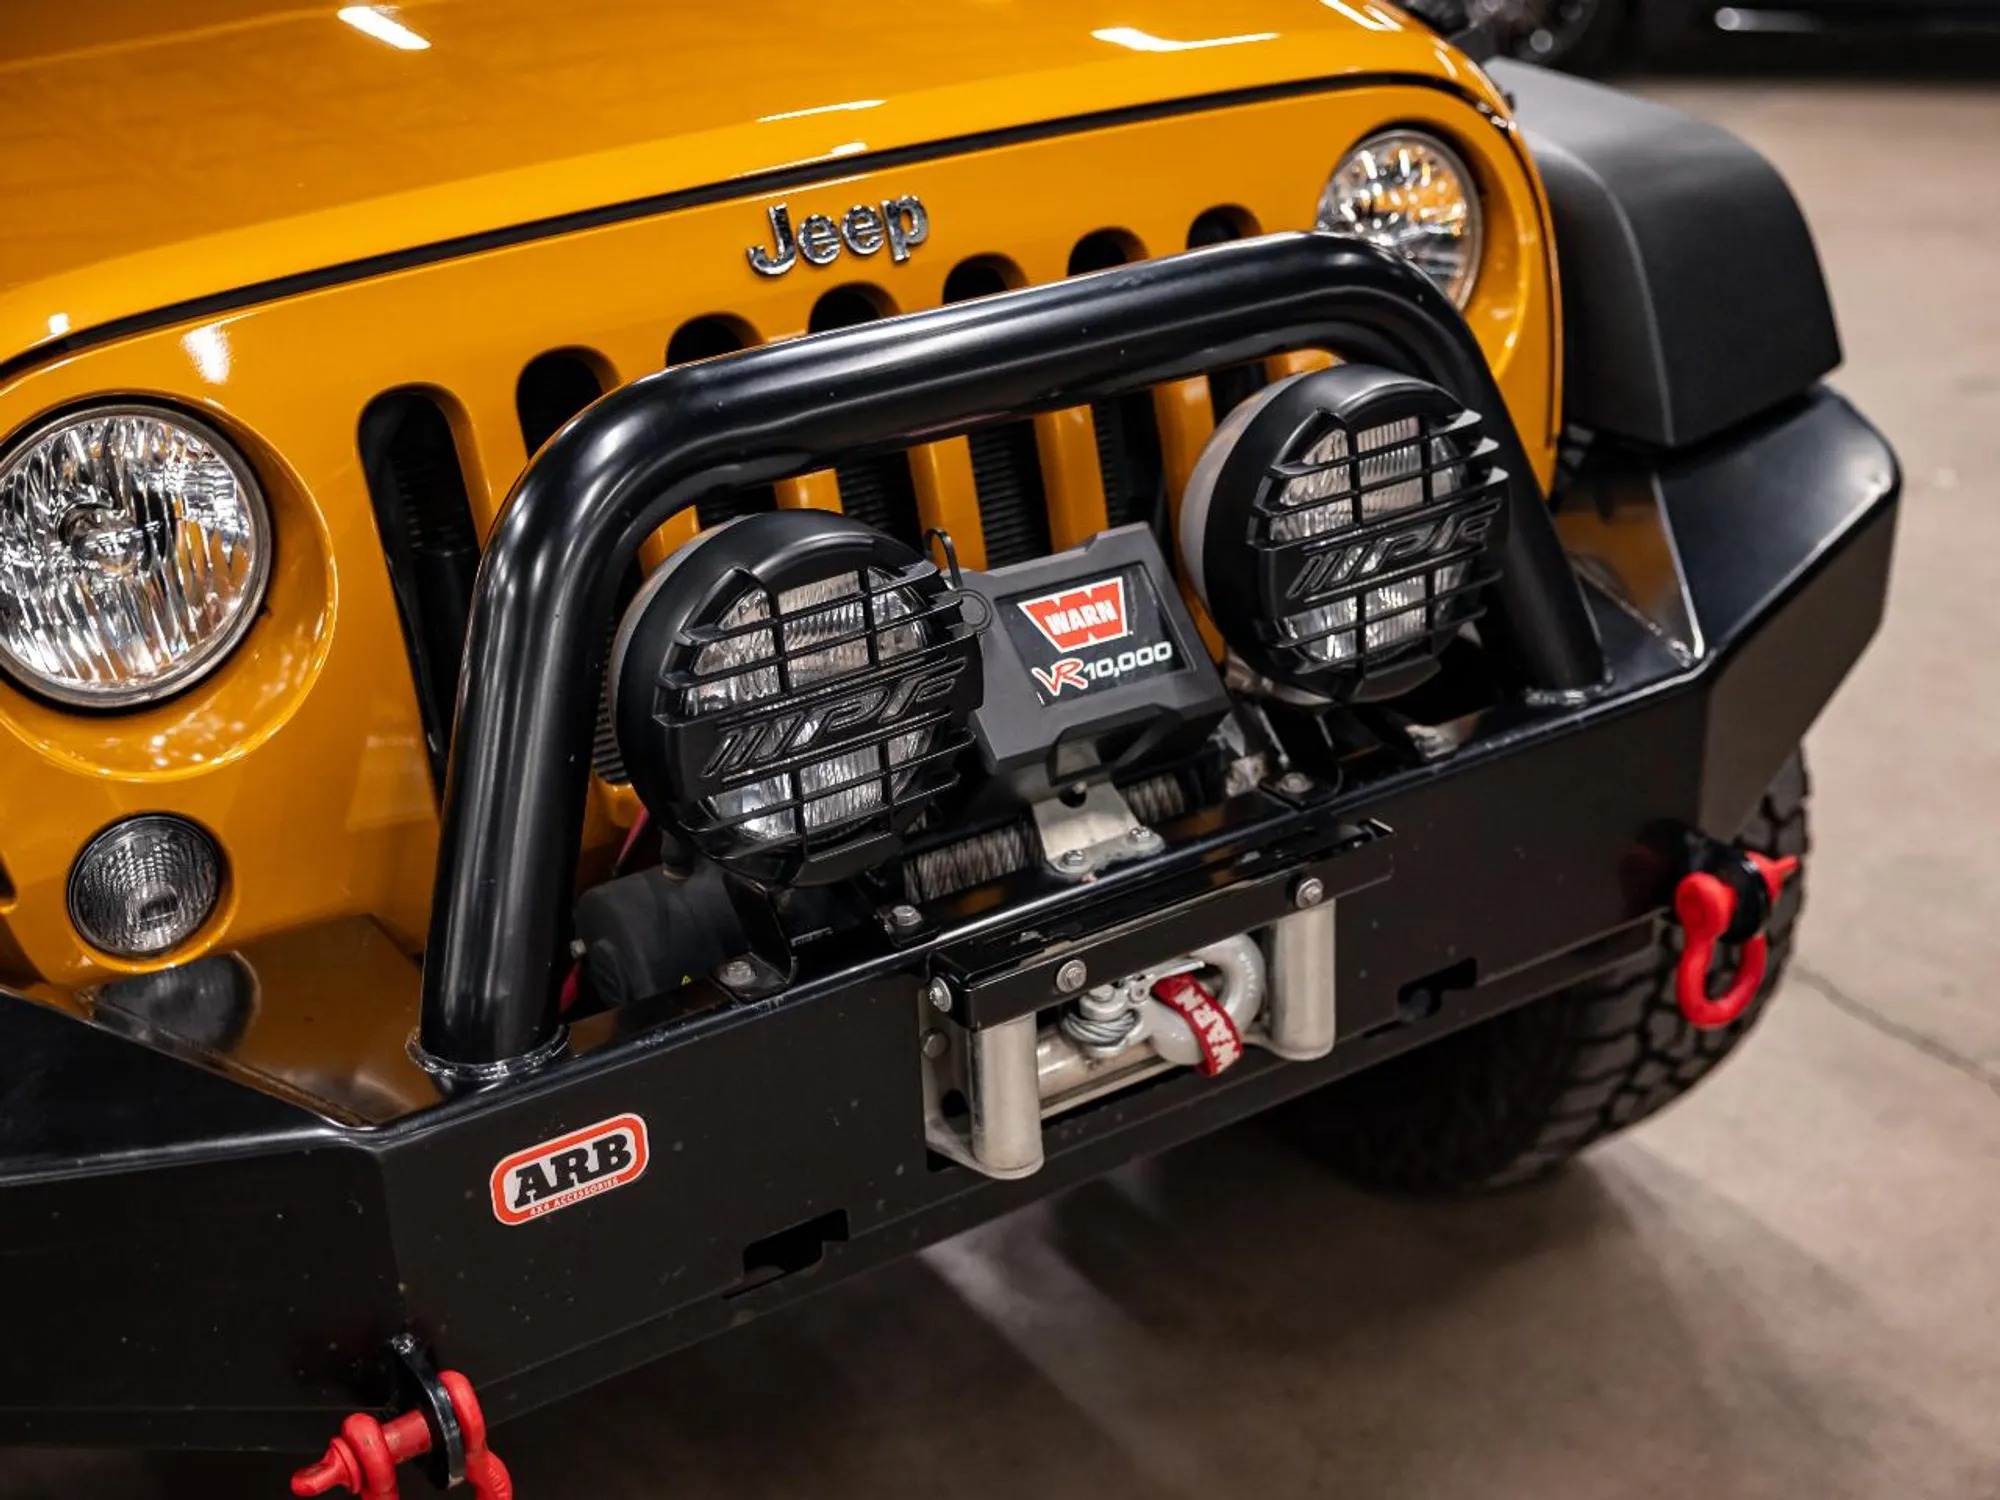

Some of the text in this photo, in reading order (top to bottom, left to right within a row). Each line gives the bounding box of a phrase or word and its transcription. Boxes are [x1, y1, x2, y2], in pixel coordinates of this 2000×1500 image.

[747, 196, 929, 275] Jeep
[1044, 599, 1118, 636] WARN
[1173, 984, 1241, 1075] WARN
[514, 1133, 632, 1209] ARB
